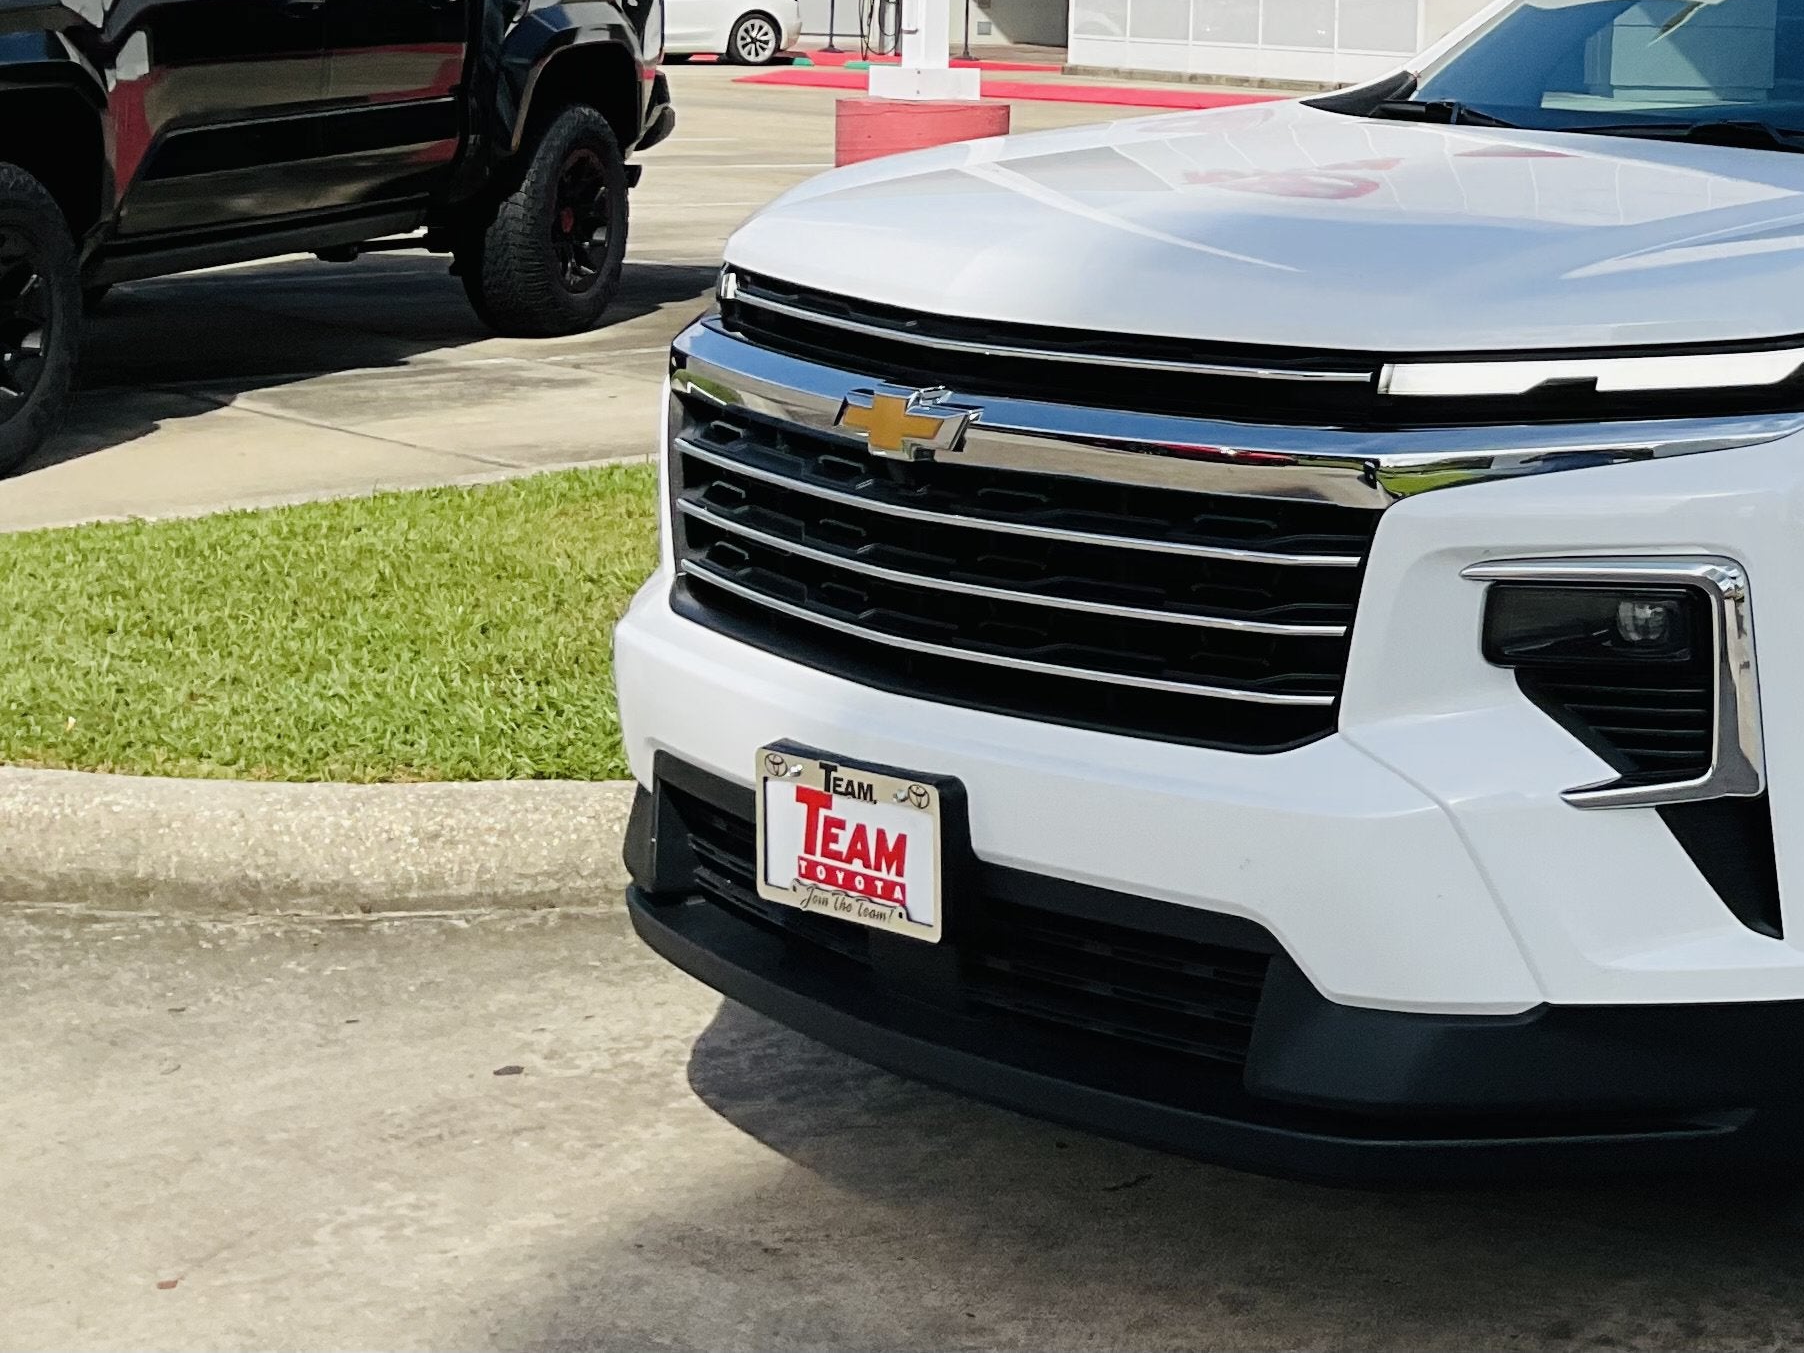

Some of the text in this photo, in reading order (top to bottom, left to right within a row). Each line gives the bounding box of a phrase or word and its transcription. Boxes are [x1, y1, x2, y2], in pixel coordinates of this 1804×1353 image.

[796, 785, 907, 877] TEAM
[800, 859, 904, 901] TOYOTA
[800, 885, 829, 909] Join
